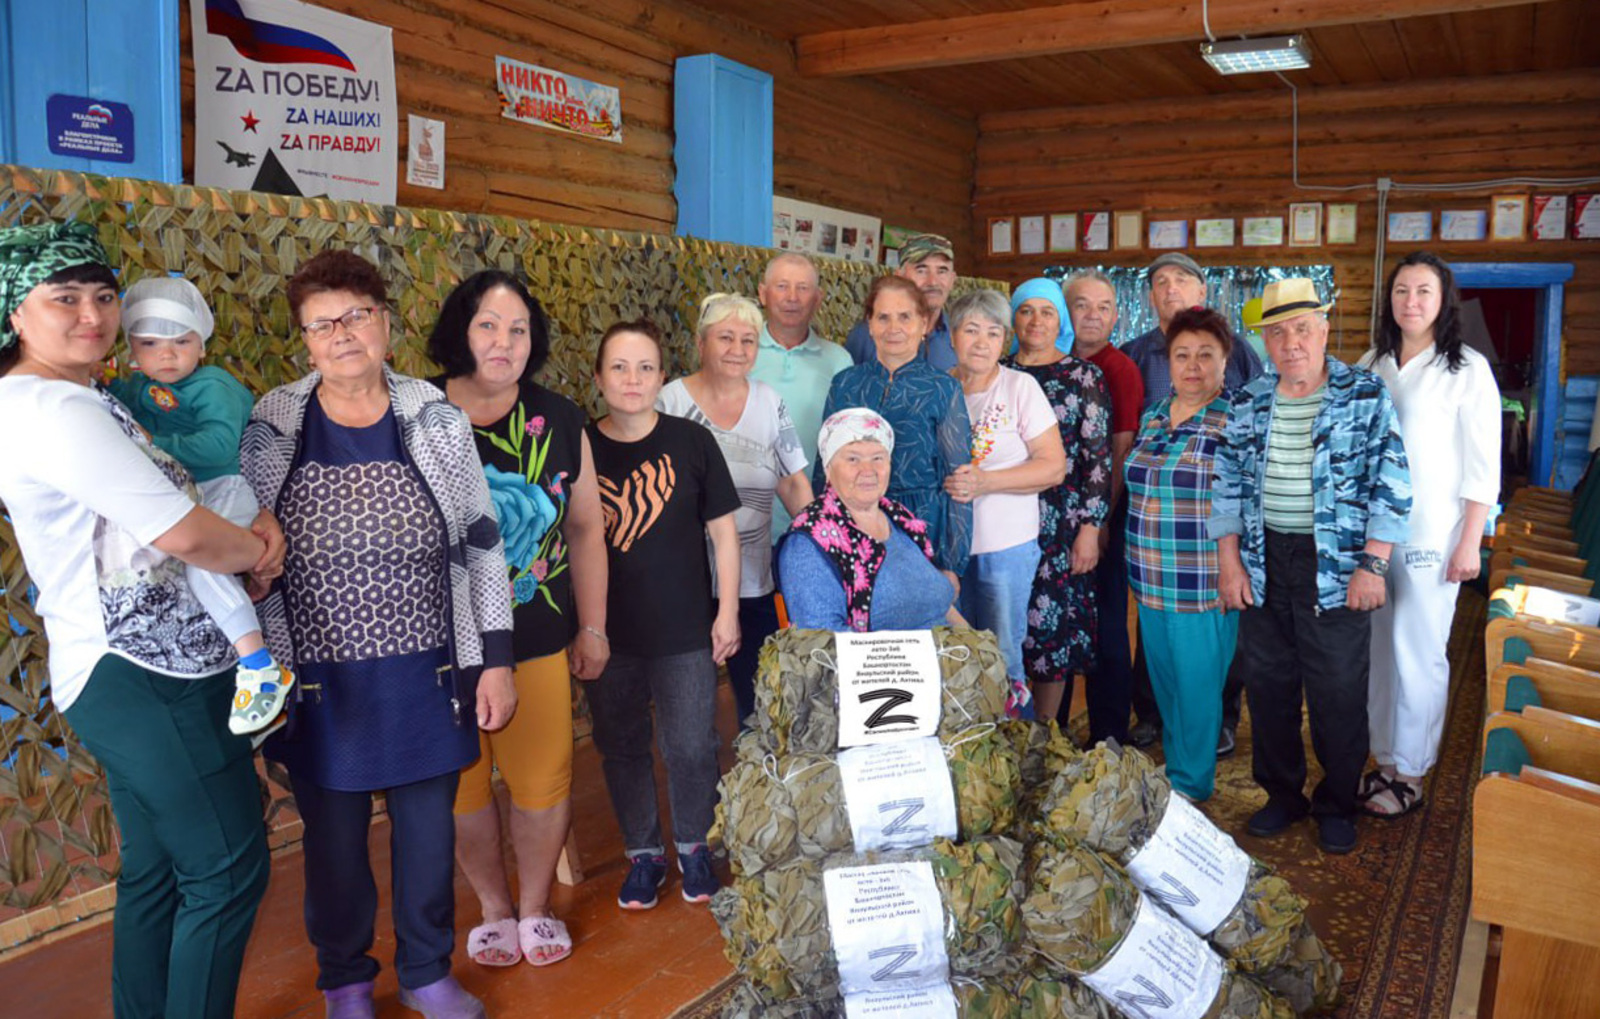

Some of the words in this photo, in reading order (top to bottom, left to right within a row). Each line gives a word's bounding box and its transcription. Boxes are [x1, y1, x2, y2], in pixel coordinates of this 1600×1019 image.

[262, 70, 380, 103] ПОБЕДУ!
[501, 63, 568, 97] НИКТО
[314, 109, 381, 127] НАШИХ!
[524, 95, 590, 126] НИЧТО
[308, 135, 381, 154] ПРАВДУ!
[858, 688, 920, 729] Z
[878, 797, 928, 837] Z
[868, 944, 922, 982] Z
